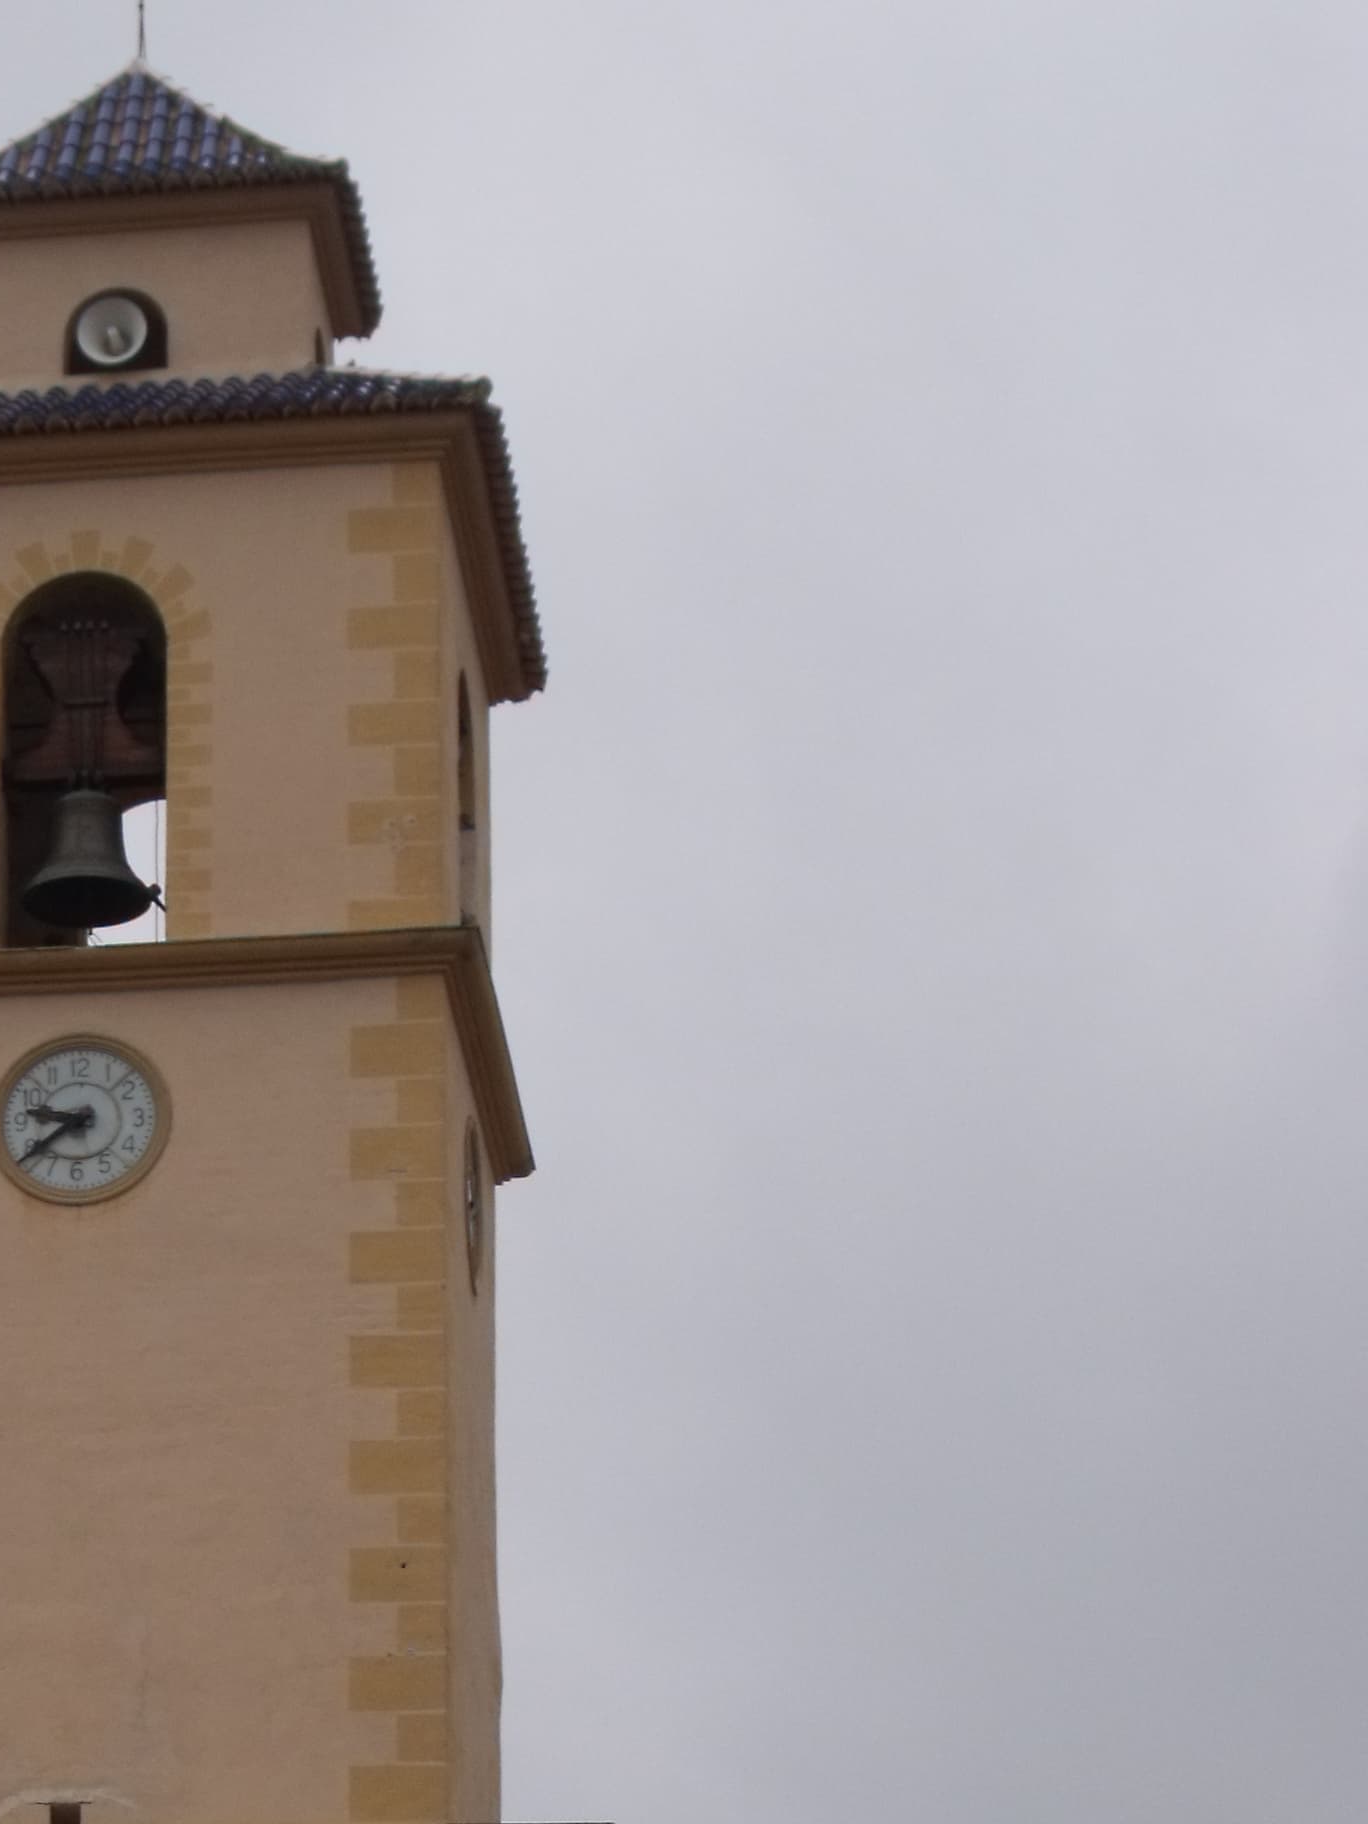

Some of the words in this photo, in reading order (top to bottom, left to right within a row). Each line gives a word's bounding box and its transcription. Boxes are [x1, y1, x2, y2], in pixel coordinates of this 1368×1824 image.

[47, 1066, 58, 1085] 11
[70, 1058, 90, 1078] 12
[23, 1088, 41, 1107] 10
[122, 1080, 135, 1100] 2
[14, 1112, 28, 1132] 9
[133, 1108, 144, 1127] 3
[121, 1135, 135, 1153] 4
[47, 1156, 58, 1176] 7
[70, 1162, 84, 1182] 6
[98, 1154, 111, 1174] 5
